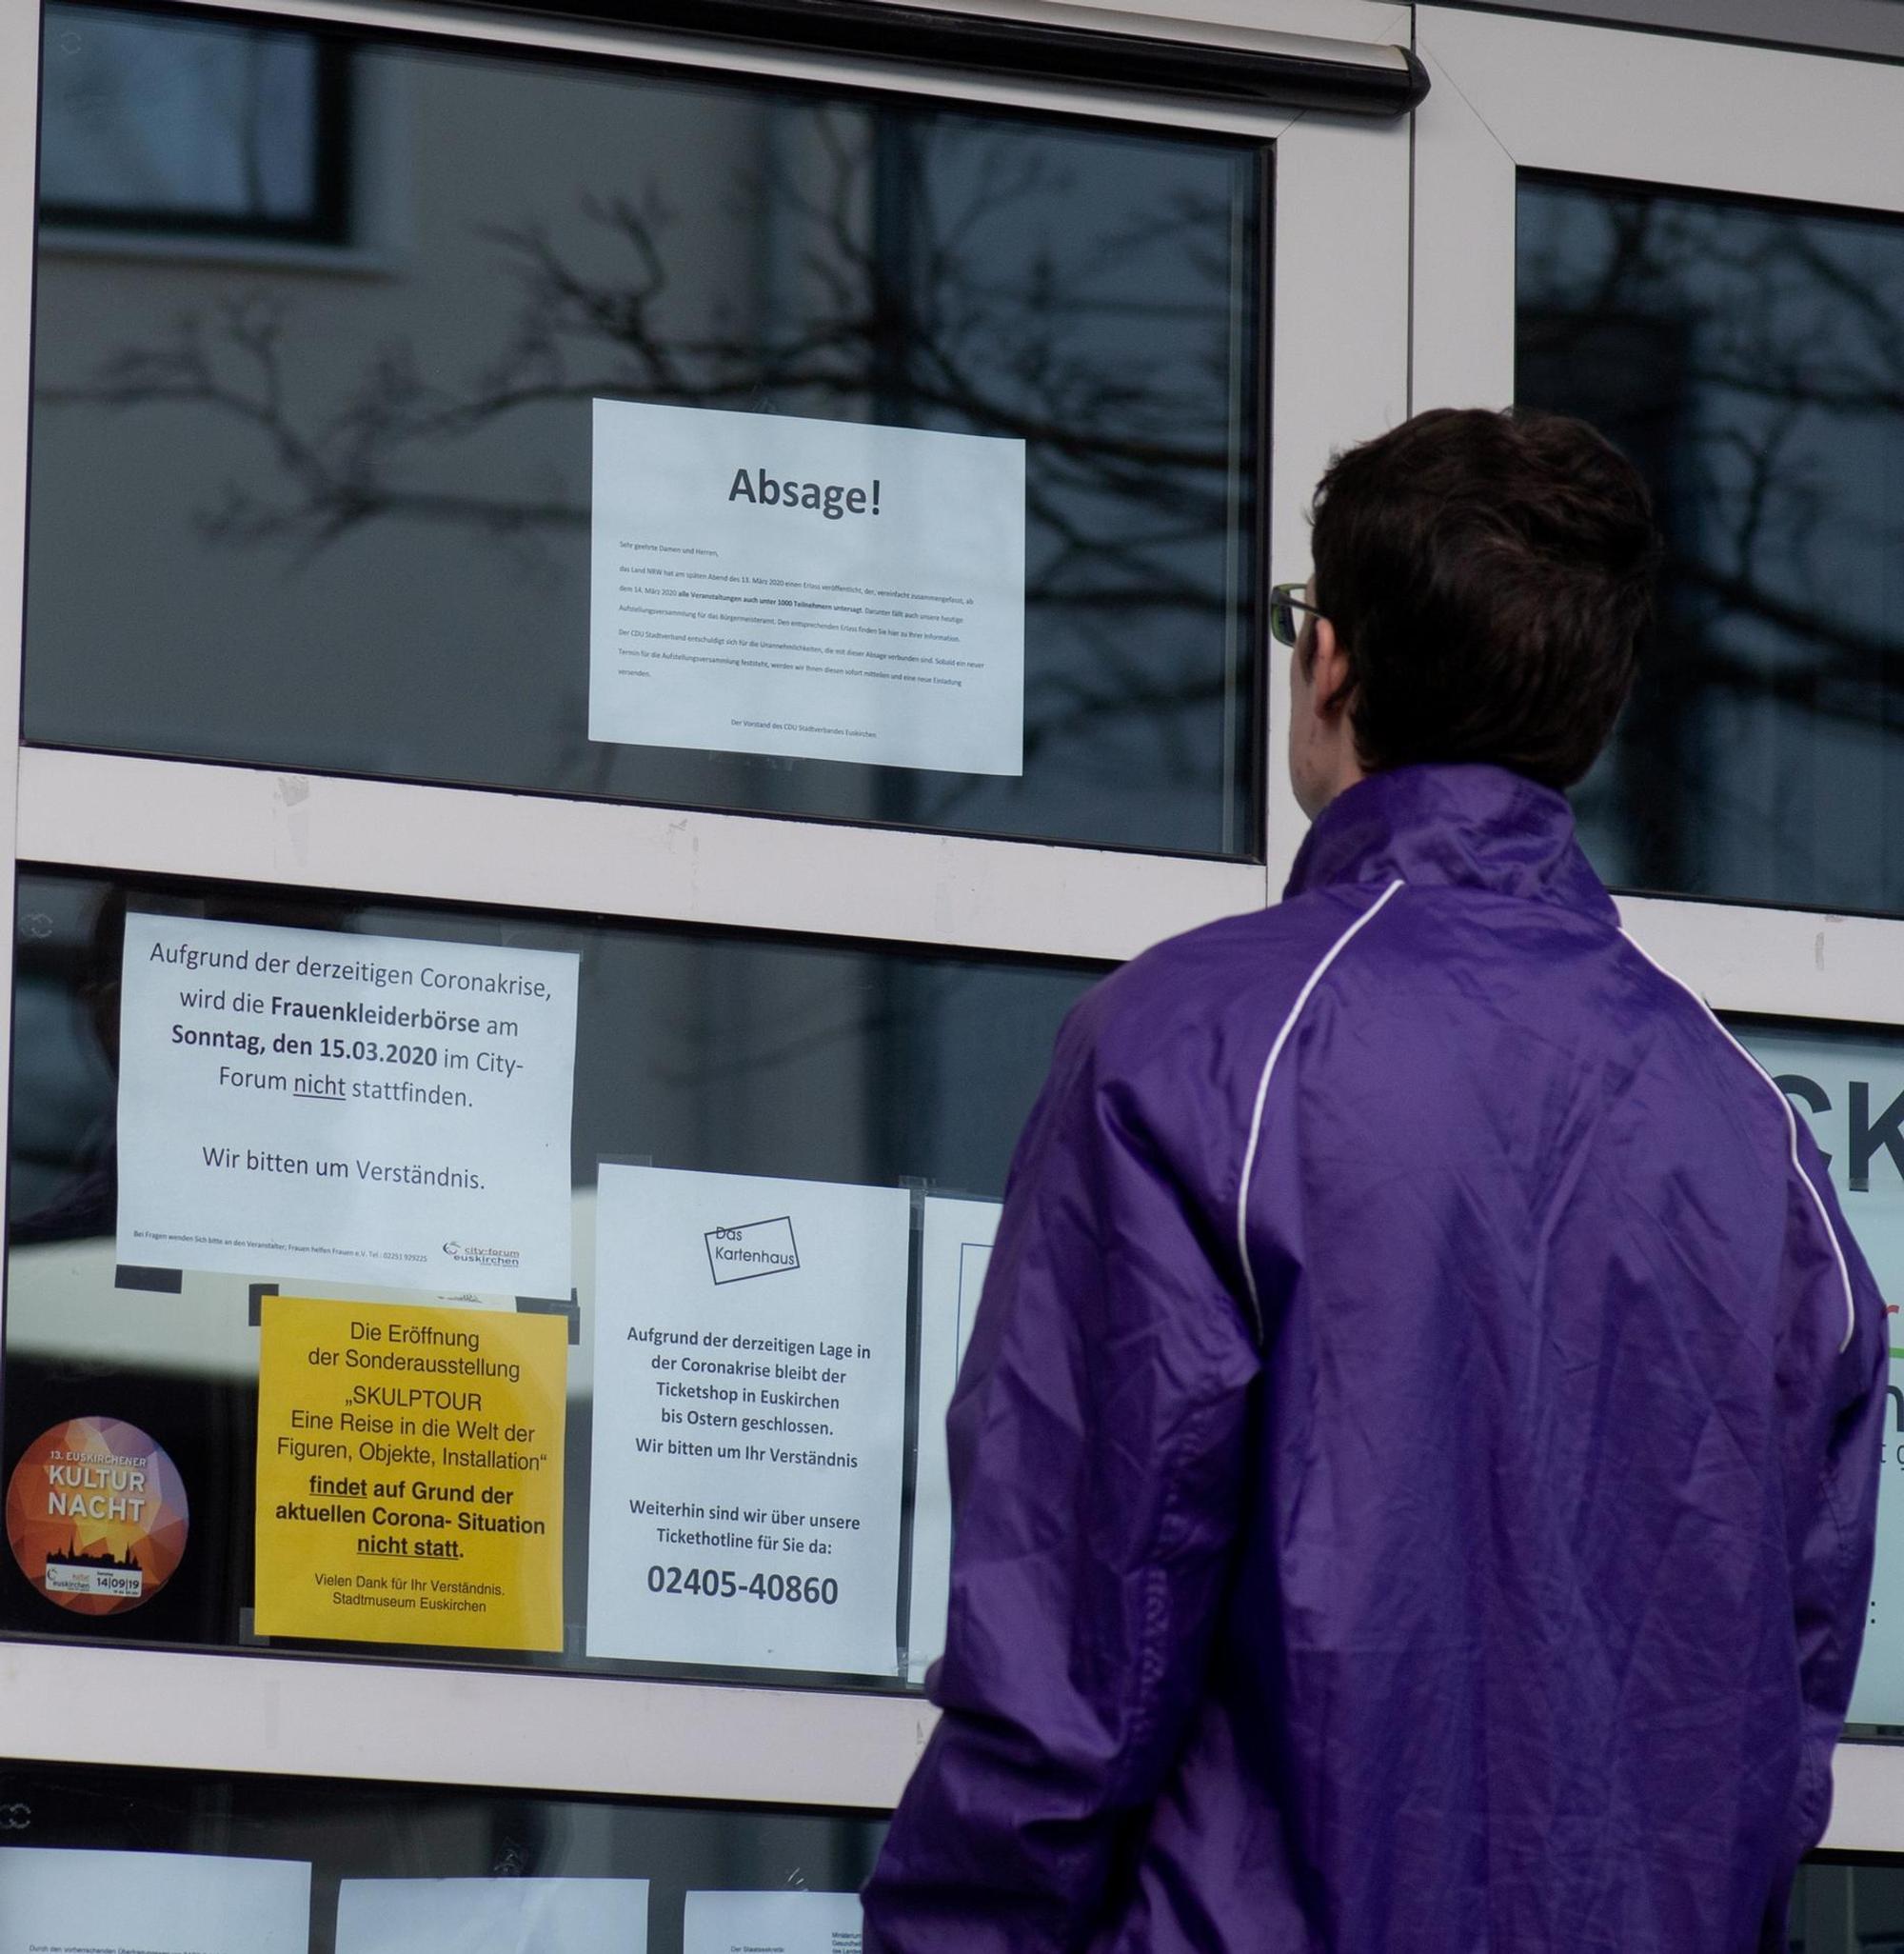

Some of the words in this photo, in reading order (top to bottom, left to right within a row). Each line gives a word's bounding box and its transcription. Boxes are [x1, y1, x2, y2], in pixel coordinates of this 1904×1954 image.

[728, 469, 881, 520] Absage!
[149, 942, 248, 970] Aufgrund
[254, 951, 290, 974] der
[295, 955, 413, 987] derzeitigen
[420, 967, 550, 1001] Coronakrise,
[179, 987, 226, 1010] wird
[232, 991, 264, 1014] die
[271, 995, 480, 1033] Frauenkleiderbörse
[486, 1020, 518, 1036] am
[171, 1024, 266, 1055] Sonntag,
[272, 1032, 312, 1056] den
[320, 1037, 437, 1067] 15.03.2020
[444, 1047, 468, 1069] im
[476, 1051, 523, 1078] City-
[219, 1066, 287, 1090] Forum
[292, 1073, 347, 1101] nicht
[351, 1080, 472, 1107] stattfinden.
[202, 1146, 240, 1168] Wir
[247, 1148, 308, 1175] bitten
[315, 1161, 348, 1178] um
[355, 1159, 485, 1189] Verständnis.
[714, 1226, 744, 1241] Das
[453, 1254, 520, 1266] euskirchen
[715, 1246, 797, 1267] Kartenhaus
[350, 1321, 382, 1342] Die
[387, 1324, 479, 1352] Eröffnung
[626, 1326, 699, 1346] Aufgrund
[702, 1331, 728, 1347] der
[731, 1333, 815, 1357] derzeitigen
[819, 1341, 853, 1361] Lage
[857, 1344, 871, 1359] in
[307, 1346, 340, 1366] der
[345, 1347, 520, 1383] Sonderausstellung
[650, 1354, 677, 1370] der
[681, 1356, 770, 1378] Coronakrise
[774, 1363, 817, 1382] bleibt
[821, 1367, 846, 1384] der
[345, 1385, 482, 1411] „SKULPTOUR
[655, 1381, 738, 1404] Ticketshop
[742, 1386, 756, 1403] in
[760, 1389, 840, 1409] Euskirchen
[291, 1408, 333, 1430] Eine
[340, 1412, 393, 1434] Reise
[400, 1416, 415, 1435] in
[421, 1418, 450, 1438] die
[455, 1420, 499, 1441] Welt
[504, 1424, 535, 1443] der
[661, 1406, 683, 1424] bis
[686, 1409, 737, 1427] Ostern
[741, 1416, 833, 1435] geschlossen.
[50, 1450, 64, 1461] 13.
[66, 1451, 147, 1467] EUSKIRCHENER
[277, 1436, 352, 1463] Figuren,
[358, 1441, 435, 1467] Objekte,
[443, 1446, 546, 1470] Installation“
[635, 1437, 664, 1453] Wir
[667, 1439, 713, 1457] bitten
[717, 1446, 741, 1459] um
[744, 1445, 766, 1461] Ihr
[769, 1447, 858, 1468] Verständnis
[49, 1465, 146, 1493] KULTUR
[308, 1474, 367, 1499] findet
[373, 1480, 406, 1498] auf
[411, 1481, 474, 1503] Grund
[481, 1485, 514, 1505] der
[48, 1491, 146, 1524] NACHT
[275, 1501, 366, 1524] aktuellen
[371, 1505, 452, 1528] Corona-
[457, 1511, 545, 1535] Situation
[628, 1499, 704, 1519] Weiterhin
[708, 1505, 739, 1521] sind
[743, 1507, 767, 1524] wir
[771, 1509, 805, 1525] über
[809, 1516, 861, 1530] unsere
[356, 1534, 407, 1559] nicht
[414, 1538, 464, 1562] statt.
[656, 1527, 753, 1549] Tickethotline
[757, 1534, 779, 1550] für
[782, 1537, 804, 1553] Sie
[808, 1538, 831, 1554] da:
[314, 1572, 352, 1586] Vielen
[355, 1574, 388, 1589] Dank
[390, 1577, 407, 1590] für
[410, 1578, 427, 1591] Ihr
[429, 1579, 505, 1596] Verständnis.
[646, 1565, 838, 1605] 02405-40860
[332, 1591, 416, 1608] Stadtmuseum
[419, 1596, 486, 1612] Euskirchen
